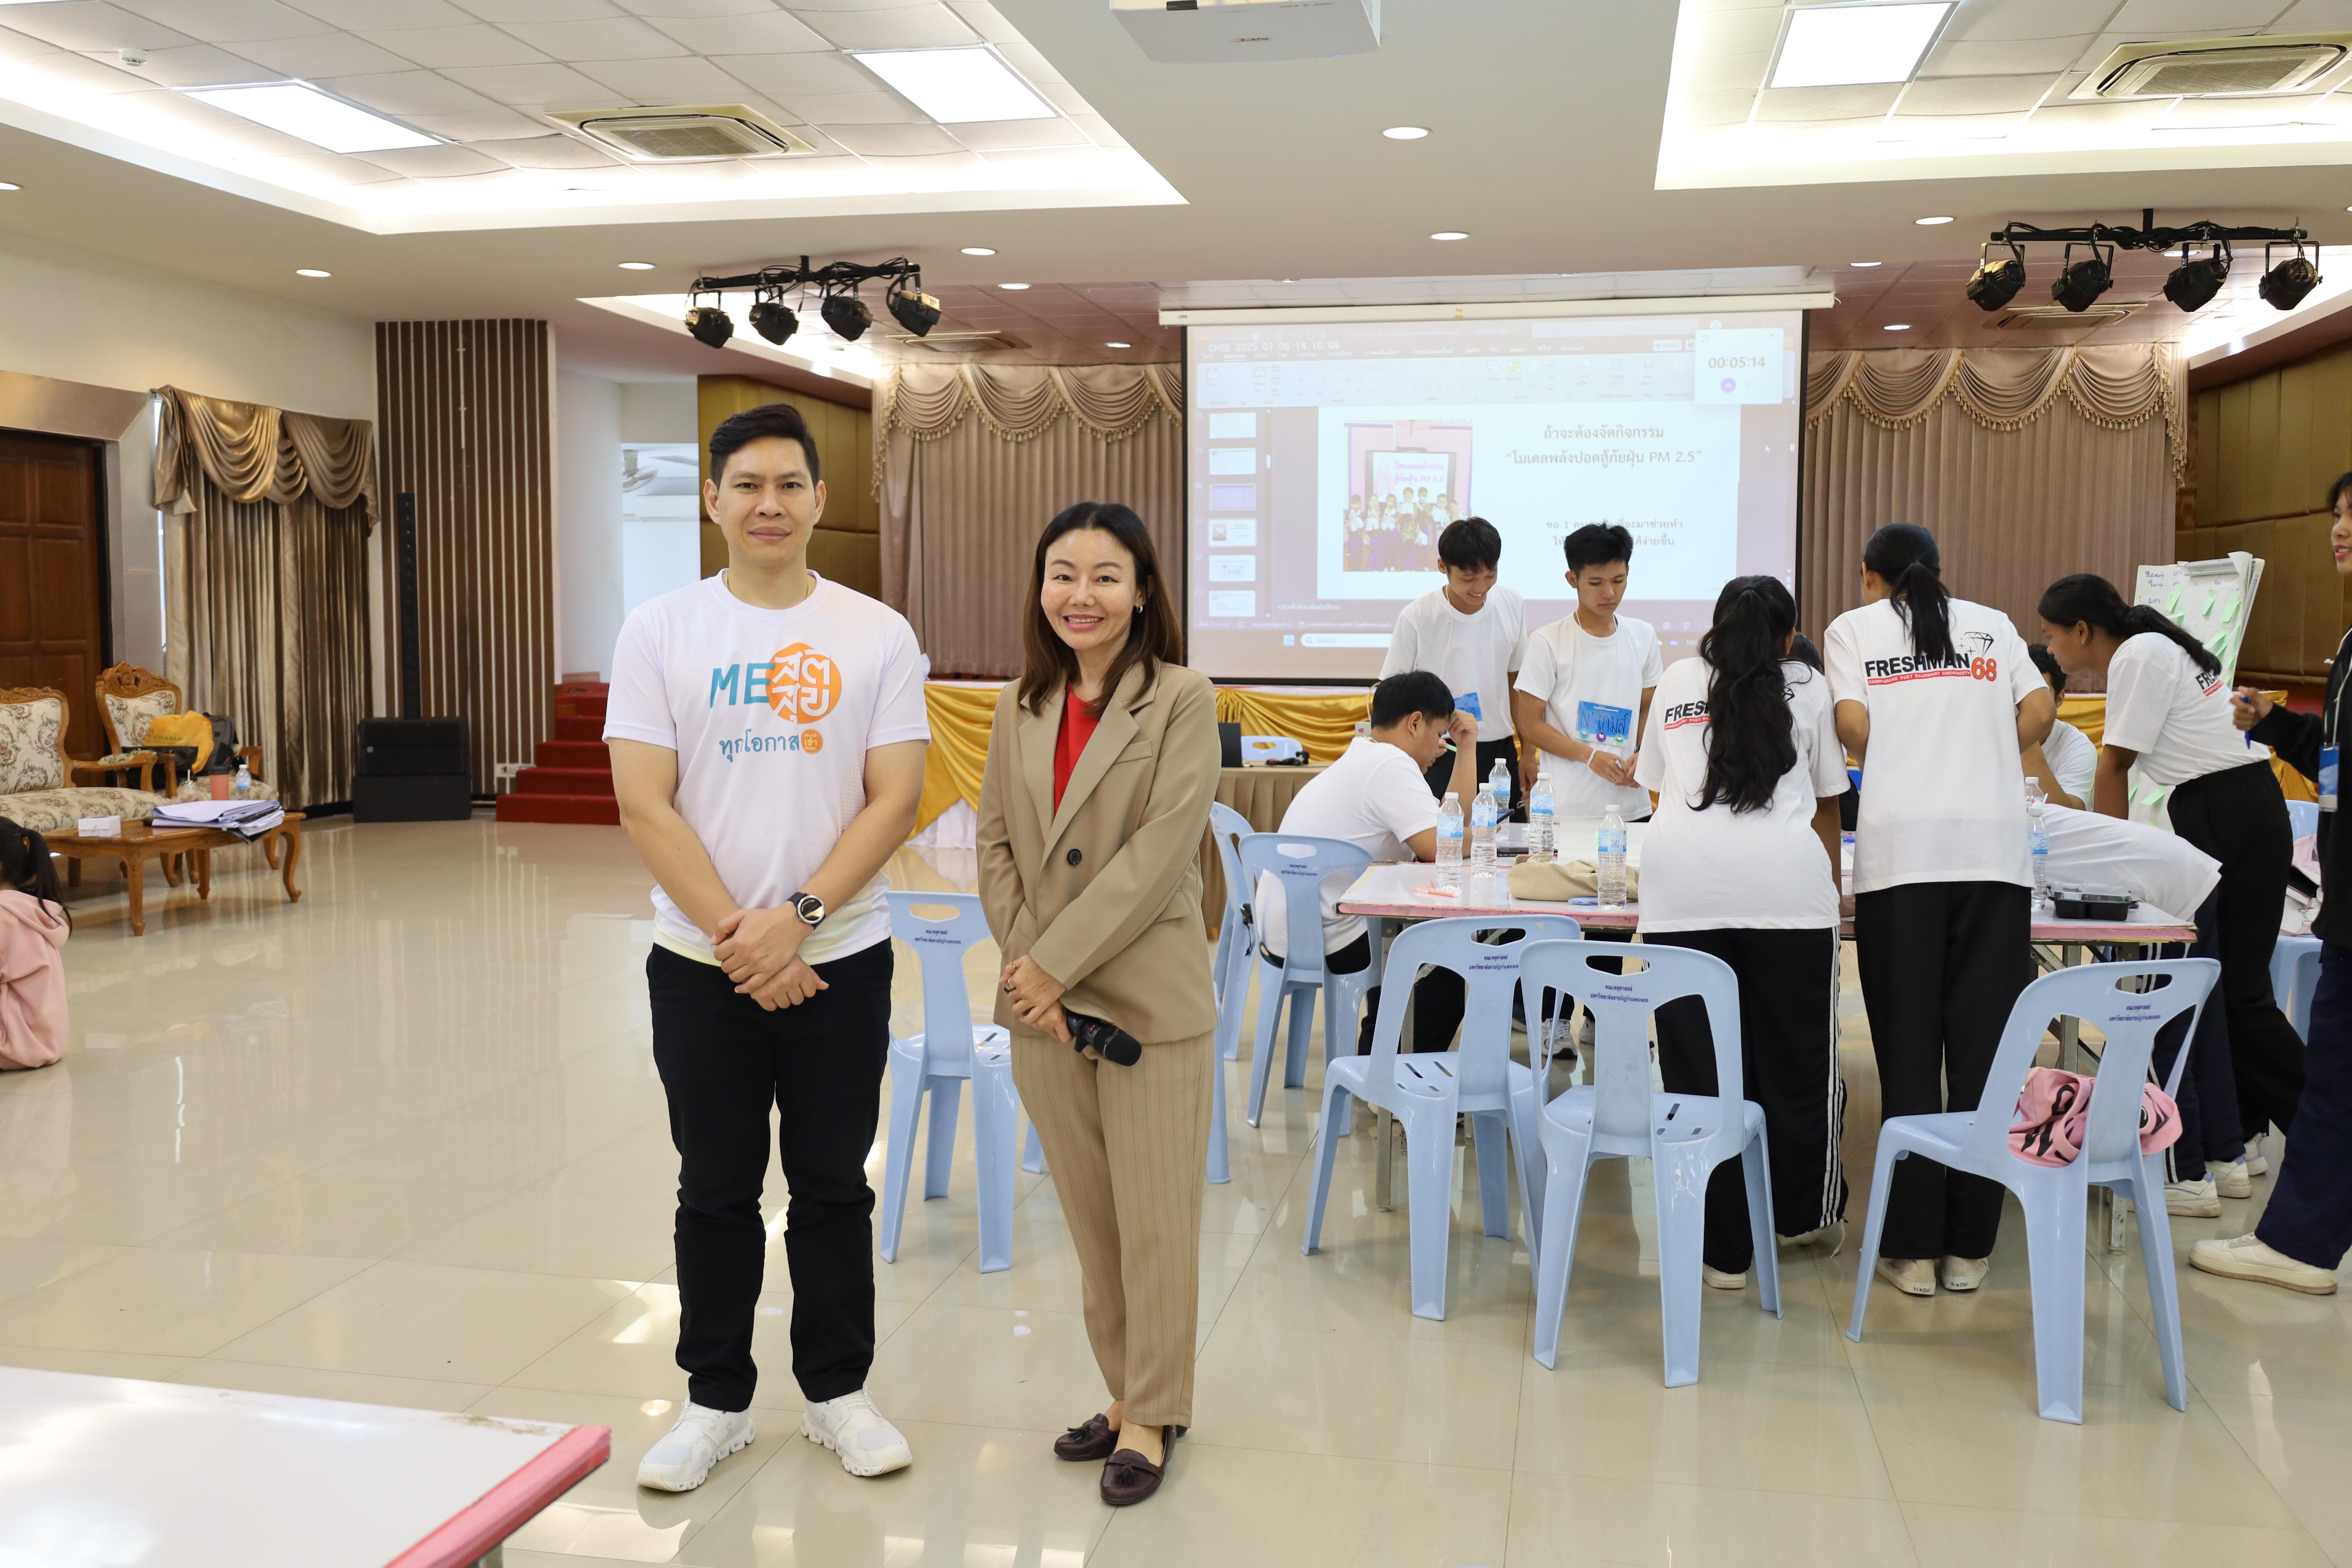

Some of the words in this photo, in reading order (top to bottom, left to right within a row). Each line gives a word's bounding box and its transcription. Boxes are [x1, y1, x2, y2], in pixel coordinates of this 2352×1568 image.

[1208, 343, 1230, 352] CH02
[1279, 341, 1290, 350] 06
[1296, 340, 1339, 350] 14:10:09
[1708, 356, 1766, 369] 00:05:14
[1544, 423, 1664, 440] ถ้าจะต้องจัดกิจกรรม
[1649, 451, 1671, 463] PM
[1546, 521, 1559, 529] ขอ
[1865, 653, 1970, 677] FRESHMAN
[1971, 657, 1997, 681] 68
[1598, 712, 1628, 734] เกมส์
[719, 729, 799, 763] ทุกโอกาส
[804, 737, 817, 747] เข้า
